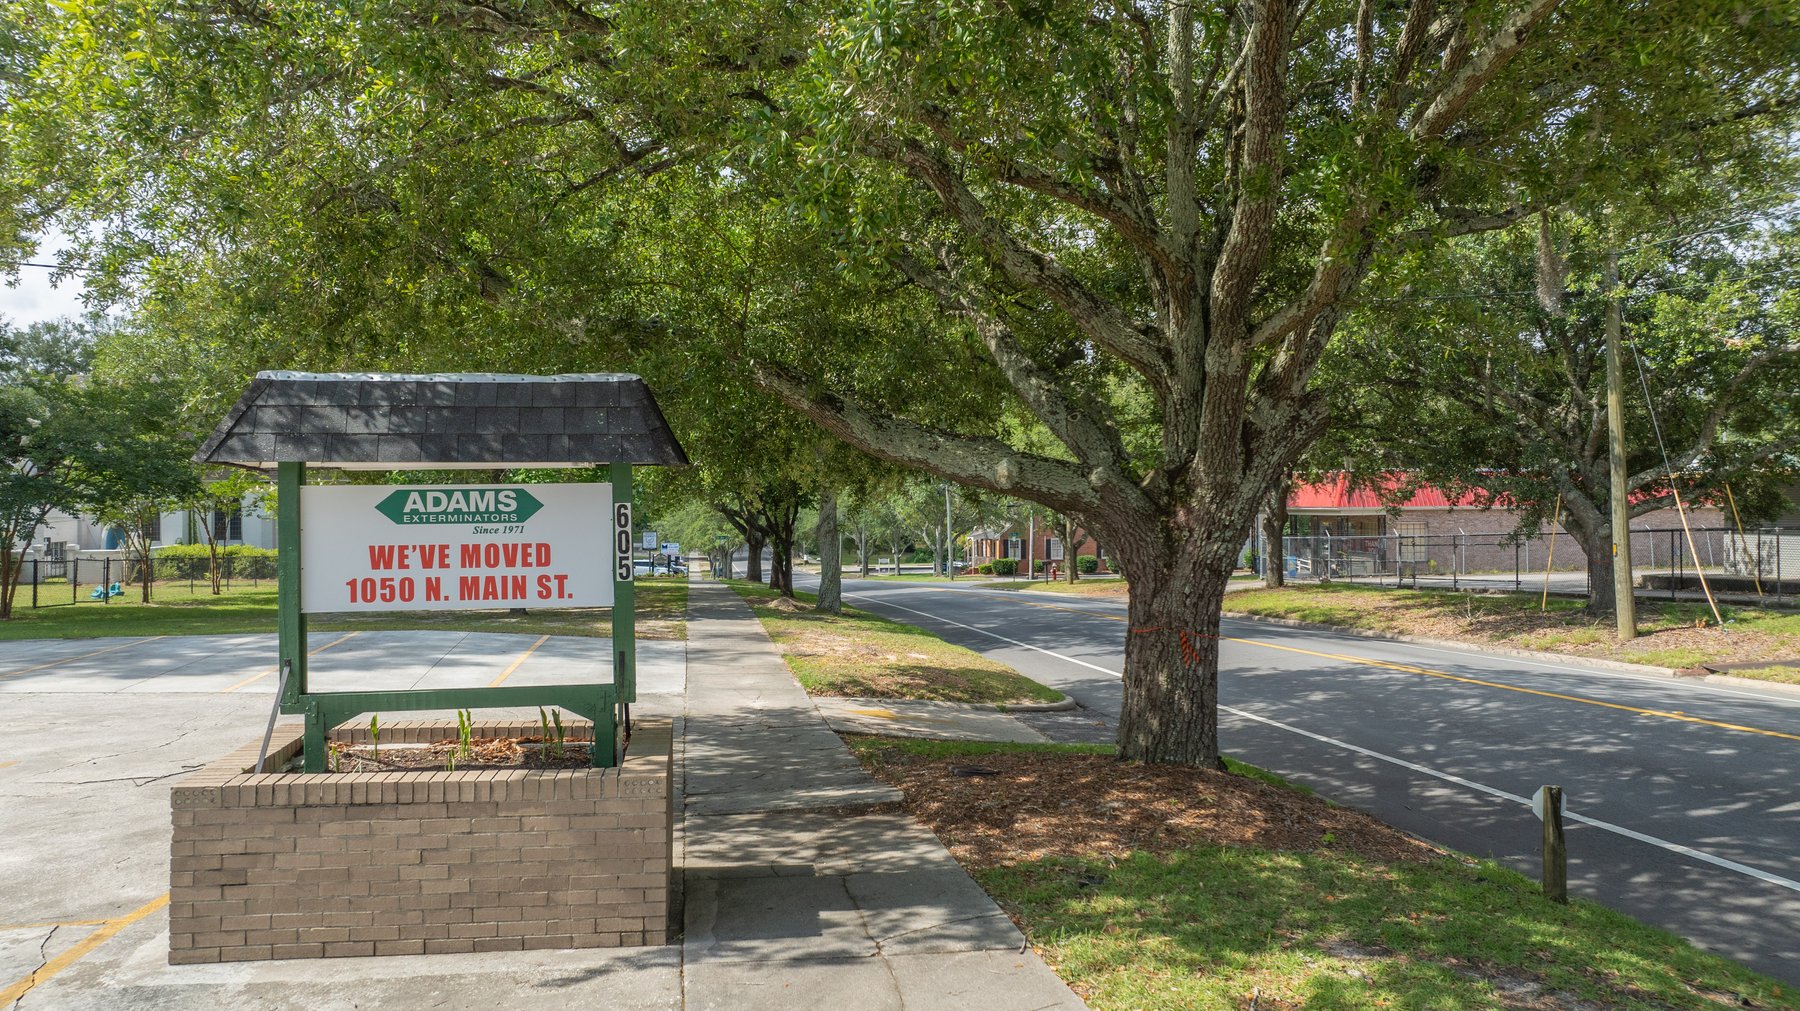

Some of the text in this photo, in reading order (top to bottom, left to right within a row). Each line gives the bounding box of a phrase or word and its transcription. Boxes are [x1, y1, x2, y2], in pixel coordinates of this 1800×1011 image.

[403, 490, 518, 513] ADAMS
[403, 513, 518, 523] EXTERMINATORS
[472, 525, 525, 535] Since 1971
[616, 503, 631, 580] 605
[368, 542, 552, 570] WE'VE MOVED
[346, 574, 574, 604] 1050 N. MAIN ST.
